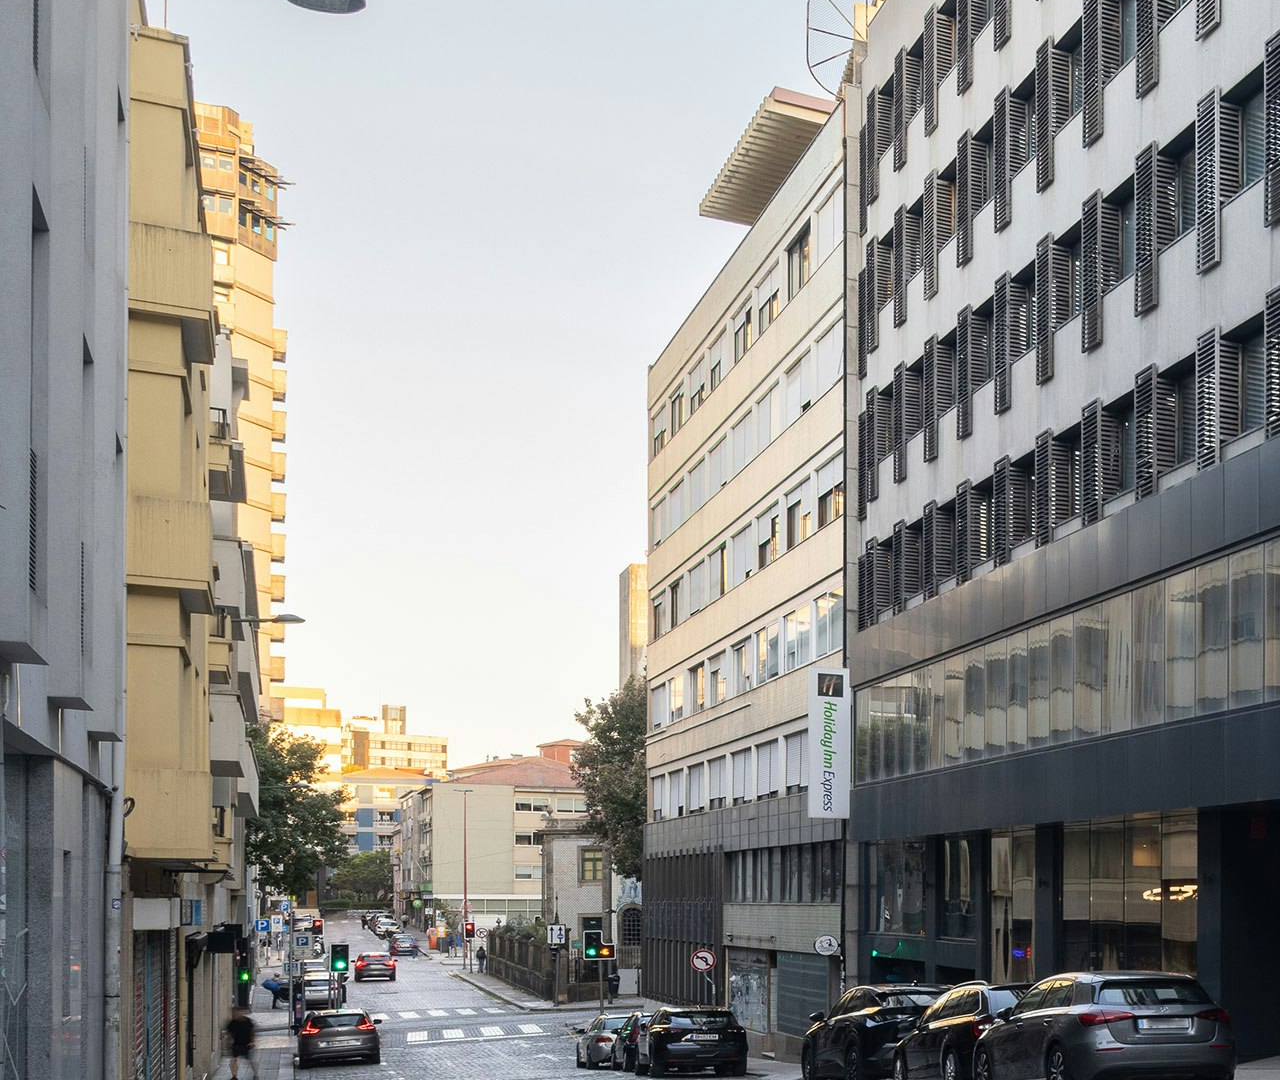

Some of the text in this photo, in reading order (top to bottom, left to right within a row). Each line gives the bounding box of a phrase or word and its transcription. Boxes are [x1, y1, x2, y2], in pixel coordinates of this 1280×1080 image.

[820, 701, 837, 812] Holiday Inn Express
